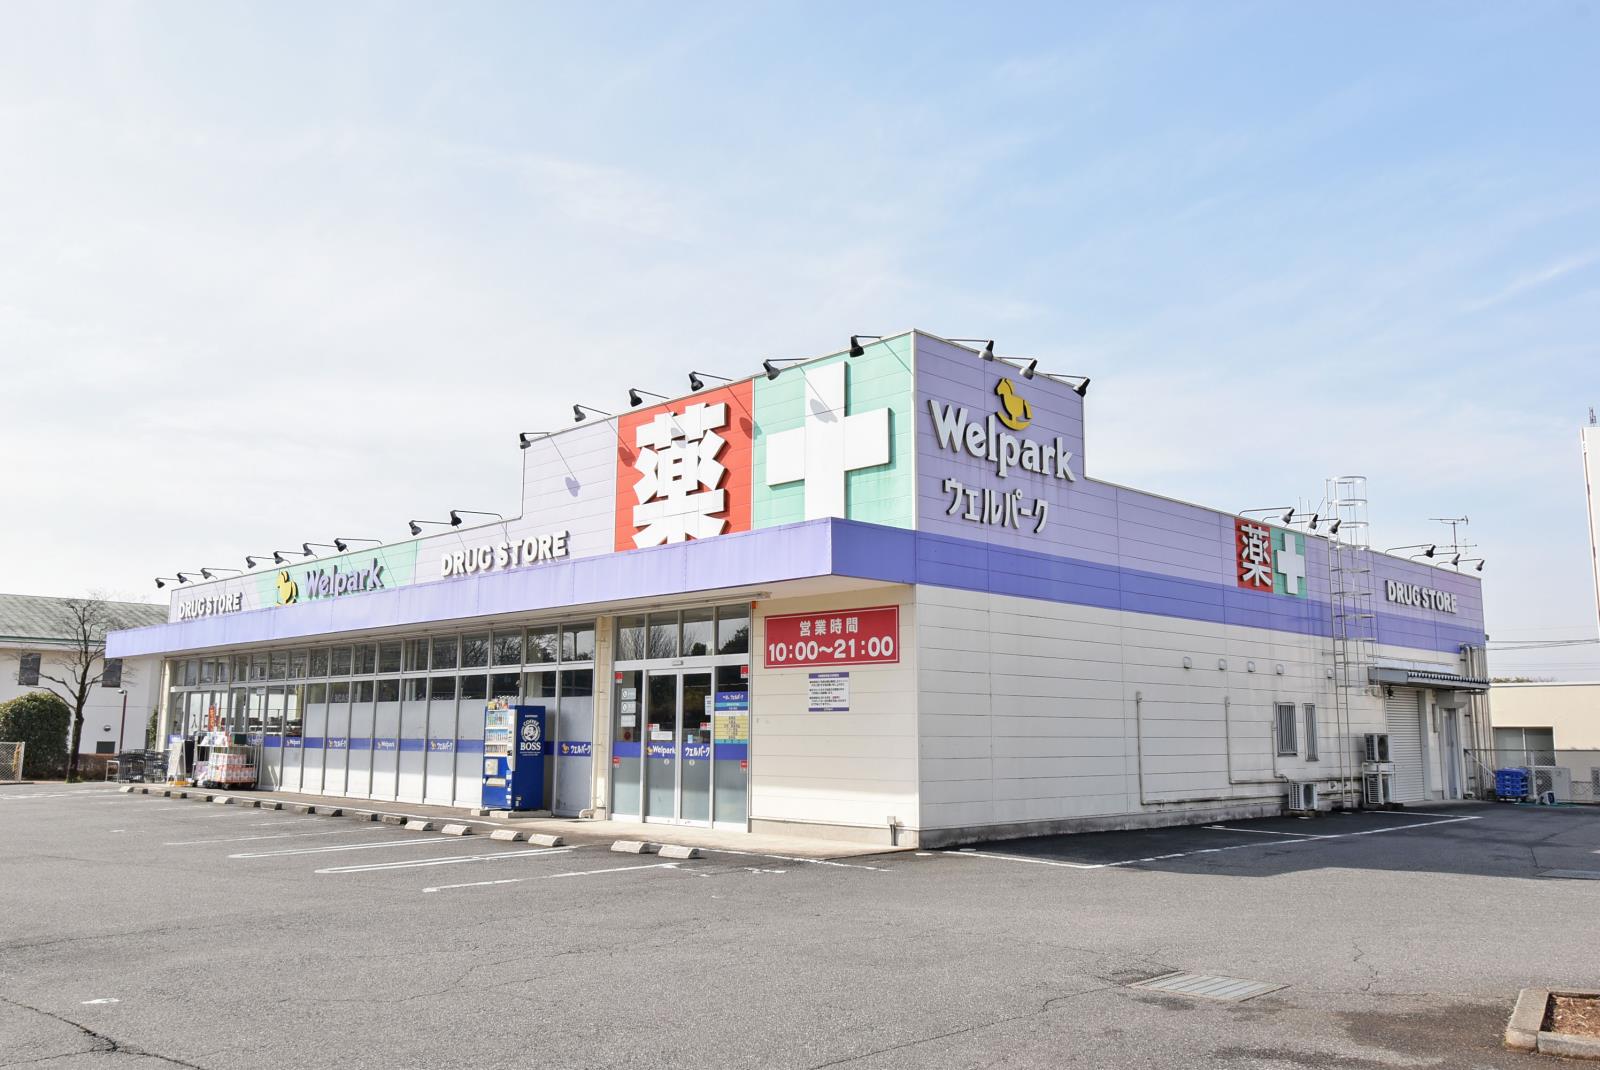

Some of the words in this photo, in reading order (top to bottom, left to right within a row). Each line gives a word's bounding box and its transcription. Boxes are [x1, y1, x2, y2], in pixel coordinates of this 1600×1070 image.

[928, 400, 1076, 482] Welpark
[632, 402, 728, 549] 薬
[441, 545, 493, 577] DRUG
[498, 530, 570, 567] STORE
[1241, 524, 1272, 587] 薬
[306, 558, 384, 599] Welpark
[1386, 580, 1420, 606] DRUG
[1420, 587, 1457, 613] STORE
[178, 598, 206, 619] DRUG
[206, 592, 242, 614] STORE
[799, 617, 858, 637] 営業時間
[520, 742, 541, 750] BOSS
